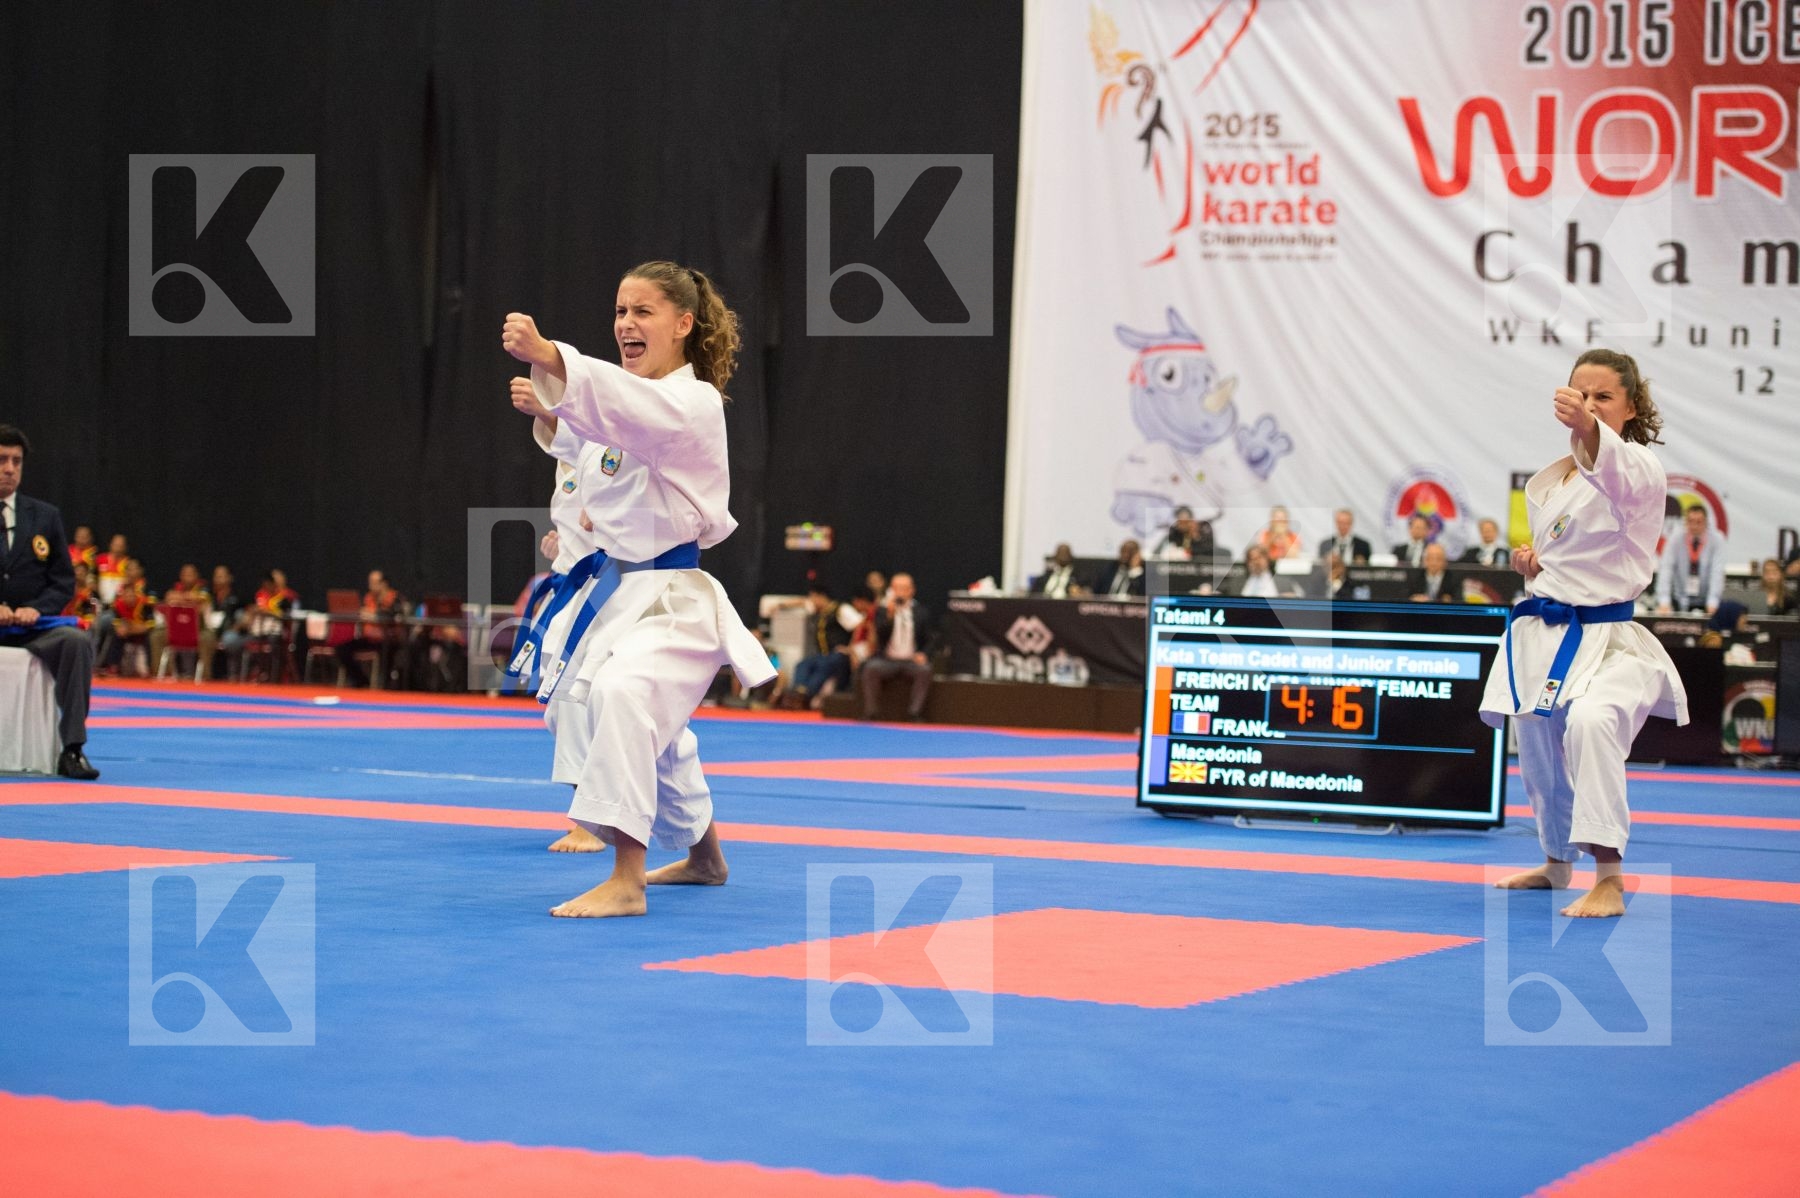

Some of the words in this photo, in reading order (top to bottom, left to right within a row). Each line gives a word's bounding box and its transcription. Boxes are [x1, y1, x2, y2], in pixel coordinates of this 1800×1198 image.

[1525, 1, 1670, 63] 2015
[1205, 113, 1281, 138] 2015
[1204, 152, 1320, 186] world
[1203, 192, 1338, 225] karate
[1734, 366, 1776, 395] 12
[1155, 607, 1211, 625] Tatami
[1213, 609, 1225, 626] 4
[1156, 646, 1195, 665] Kata
[1198, 647, 1245, 667] Team
[1247, 650, 1298, 669] Cadet
[1300, 653, 1334, 670] and
[1337, 655, 1394, 673] Junior
[1397, 656, 1459, 675] Female
[1175, 671, 1249, 691] FRENCH
[1377, 679, 1452, 699] FEMALE
[1169, 694, 1220, 712] TEAM
[1212, 718, 1287, 738] FRANC
[1171, 743, 1263, 764] Macedonia
[1209, 768, 1246, 786] FYR
[1249, 770, 1268, 788] of
[1270, 771, 1364, 793] Macedonia
